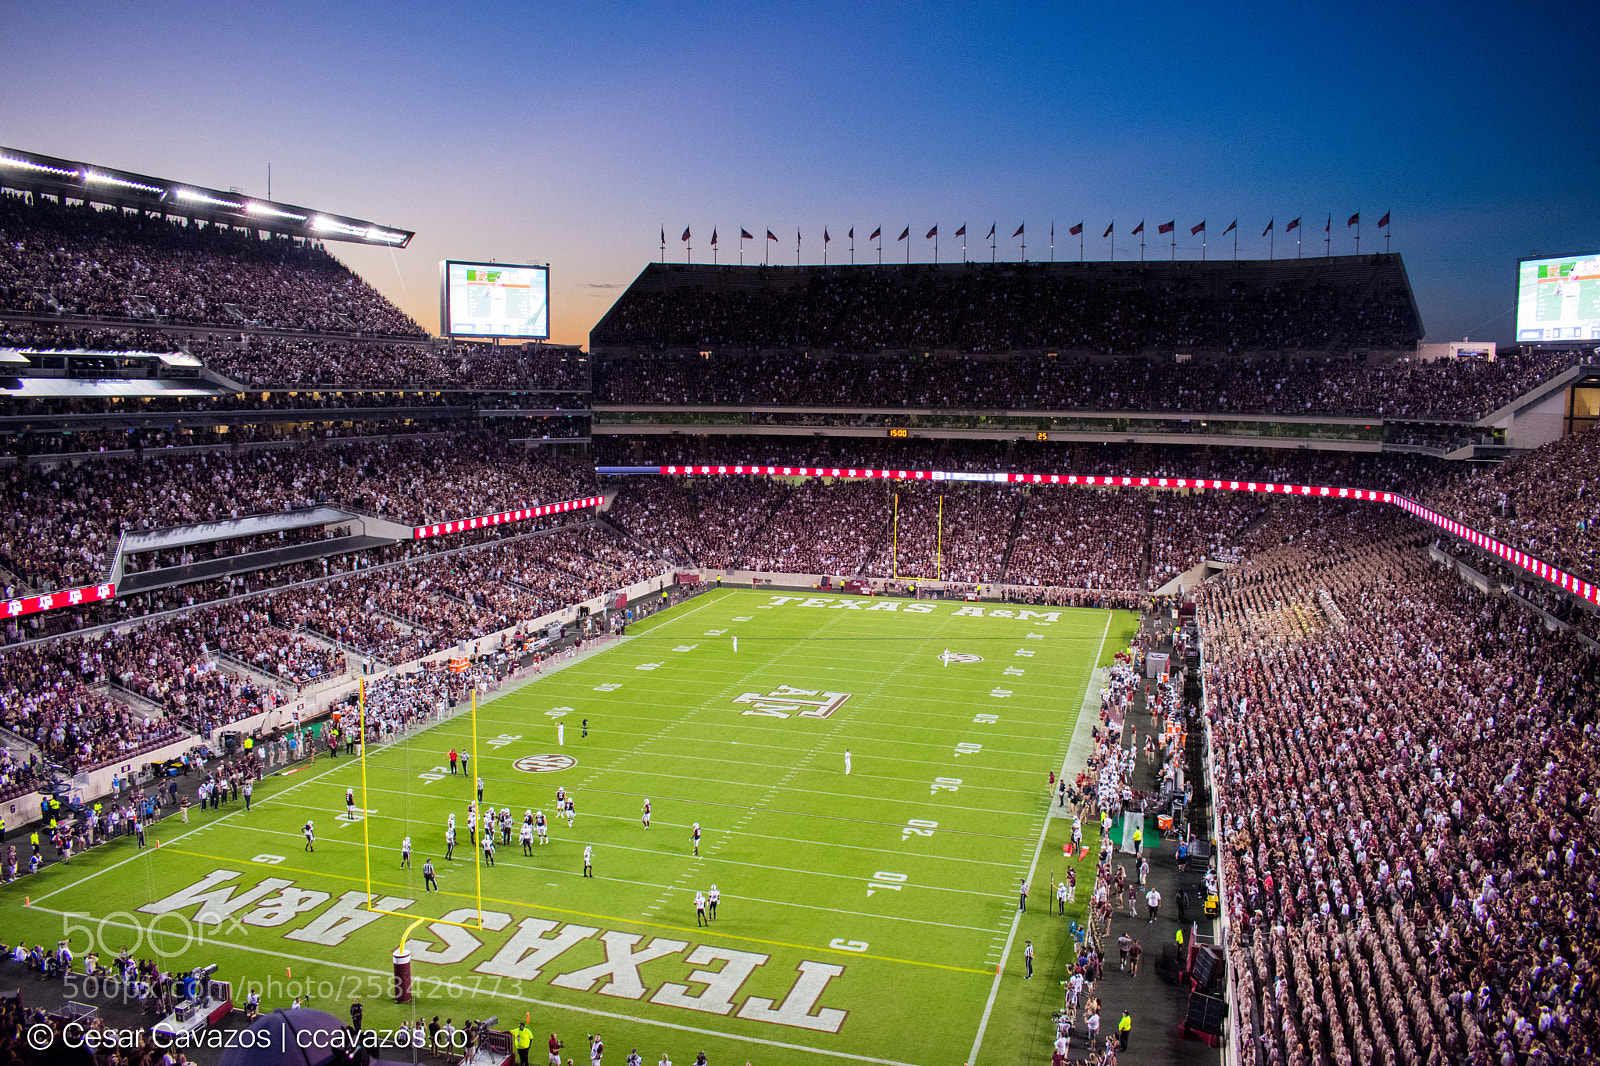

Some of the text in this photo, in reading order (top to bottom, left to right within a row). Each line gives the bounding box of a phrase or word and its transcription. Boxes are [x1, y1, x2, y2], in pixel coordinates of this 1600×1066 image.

[889, 429, 908, 438] 15:00
[1037, 432, 1047, 441] 25
[768, 596, 1063, 622] TEXAS A&M
[972, 713, 1000, 724] 50
[485, 733, 523, 746] 30
[954, 742, 983, 754] 40
[930, 777, 963, 792] 30
[902, 818, 939, 837] 20
[250, 853, 287, 865] G
[867, 871, 908, 891] 10
[134, 868, 850, 1034] TEXAS A&M
[829, 938, 869, 952] G
